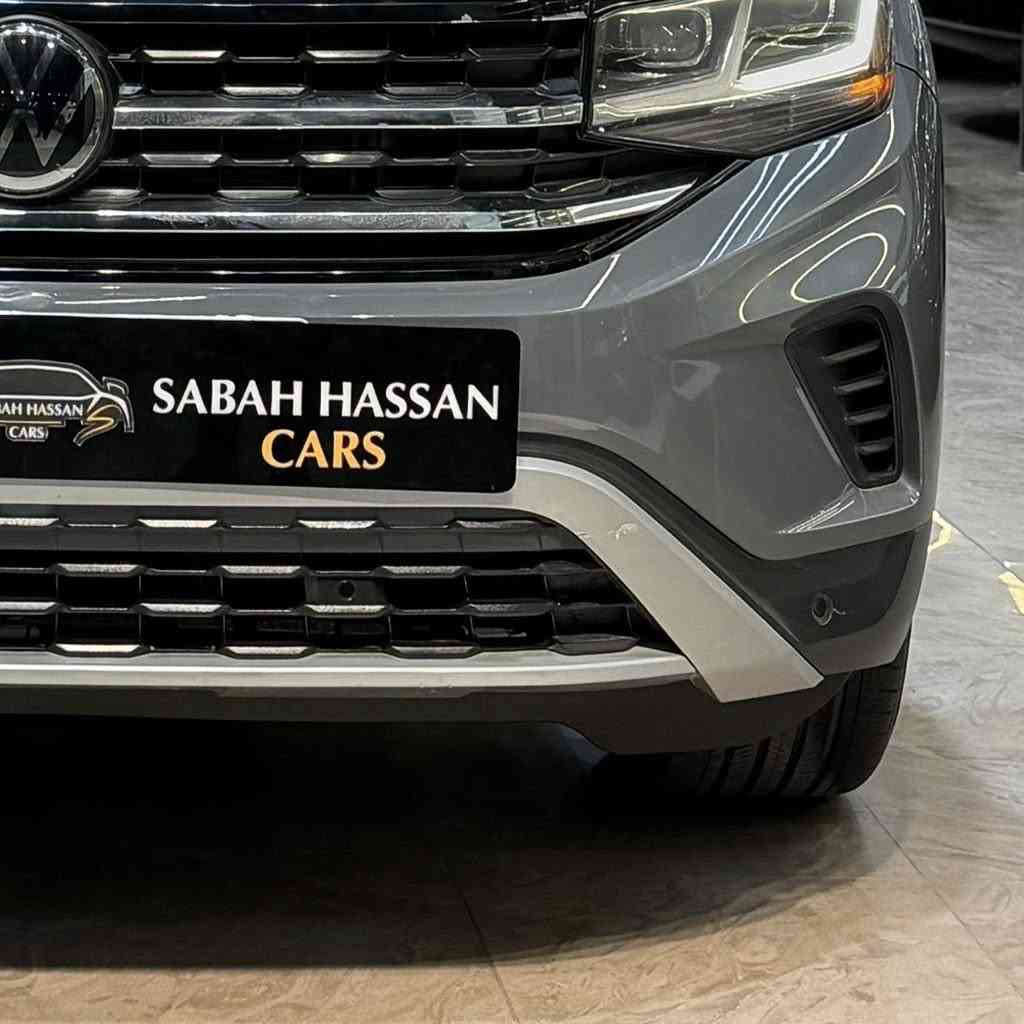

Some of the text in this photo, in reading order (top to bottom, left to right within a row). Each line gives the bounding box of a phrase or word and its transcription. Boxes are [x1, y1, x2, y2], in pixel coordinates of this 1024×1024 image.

[26, 402, 84, 417] HASSAN
[152, 377, 500, 421] SABAH HASSAN
[8, 425, 46, 439] CARS
[261, 428, 387, 471] CARS
